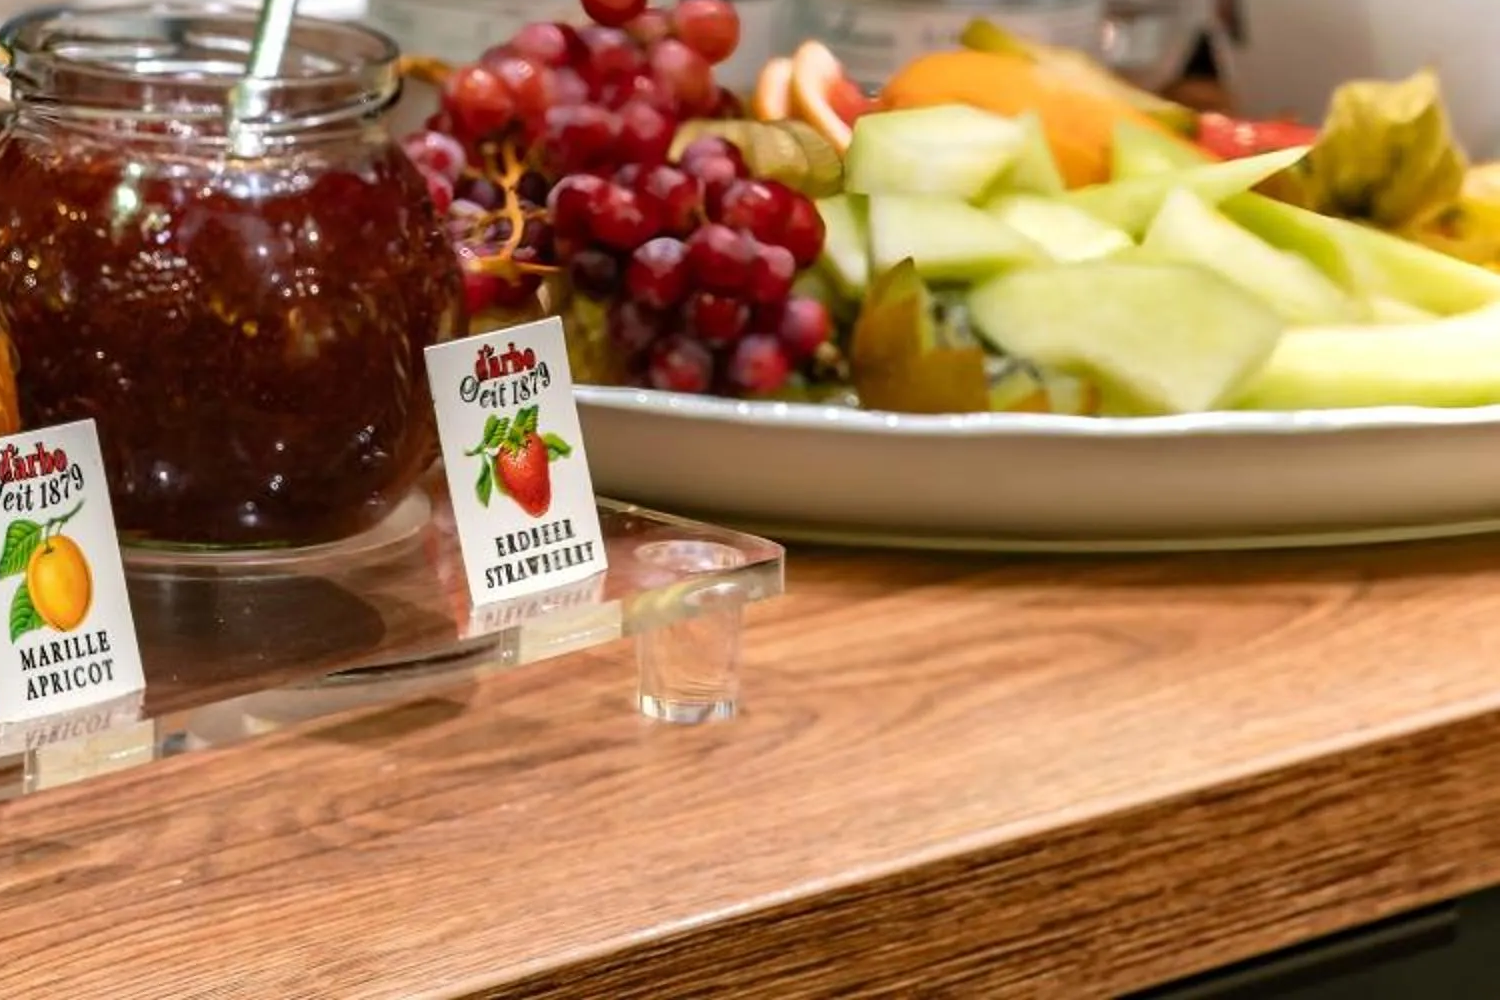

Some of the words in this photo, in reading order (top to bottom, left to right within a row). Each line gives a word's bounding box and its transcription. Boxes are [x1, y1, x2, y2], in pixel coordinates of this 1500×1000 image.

[460, 375, 506, 408] Seit
[512, 361, 551, 404] 1879
[40, 463, 85, 508] 1879
[19, 631, 111, 671] MARILLE
[27, 659, 115, 701] APRICOT
